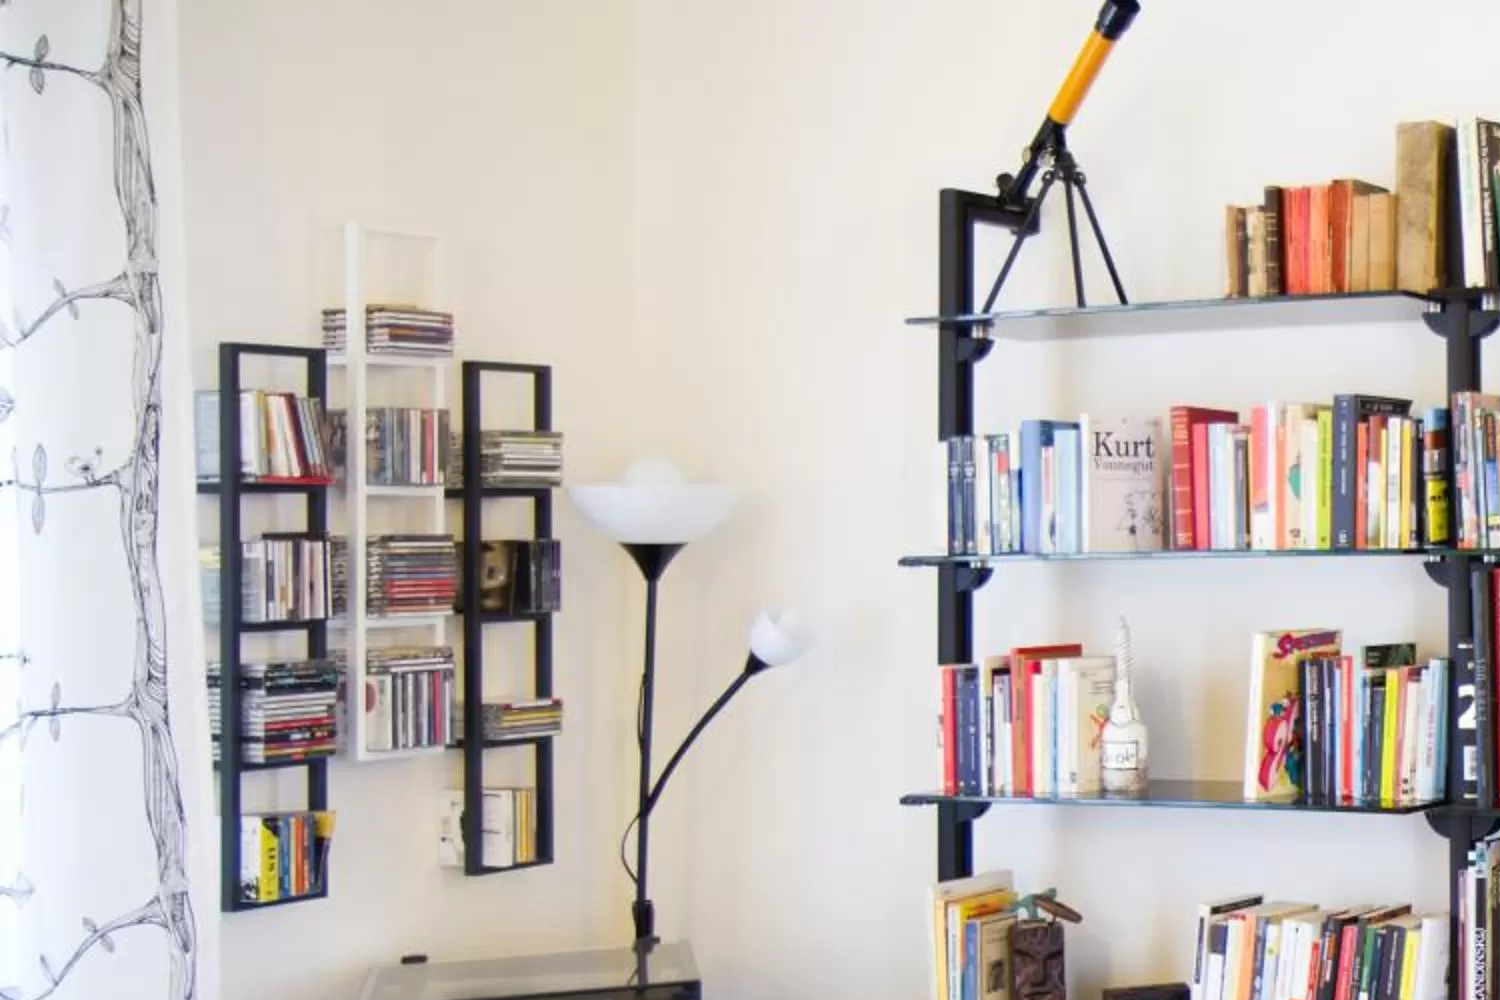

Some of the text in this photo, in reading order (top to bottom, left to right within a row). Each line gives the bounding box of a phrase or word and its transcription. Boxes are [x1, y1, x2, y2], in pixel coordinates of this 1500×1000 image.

[1093, 431, 1154, 458] Kurt
[1093, 458, 1153, 474] Vonnegut
[1458, 684, 1476, 729] 2
